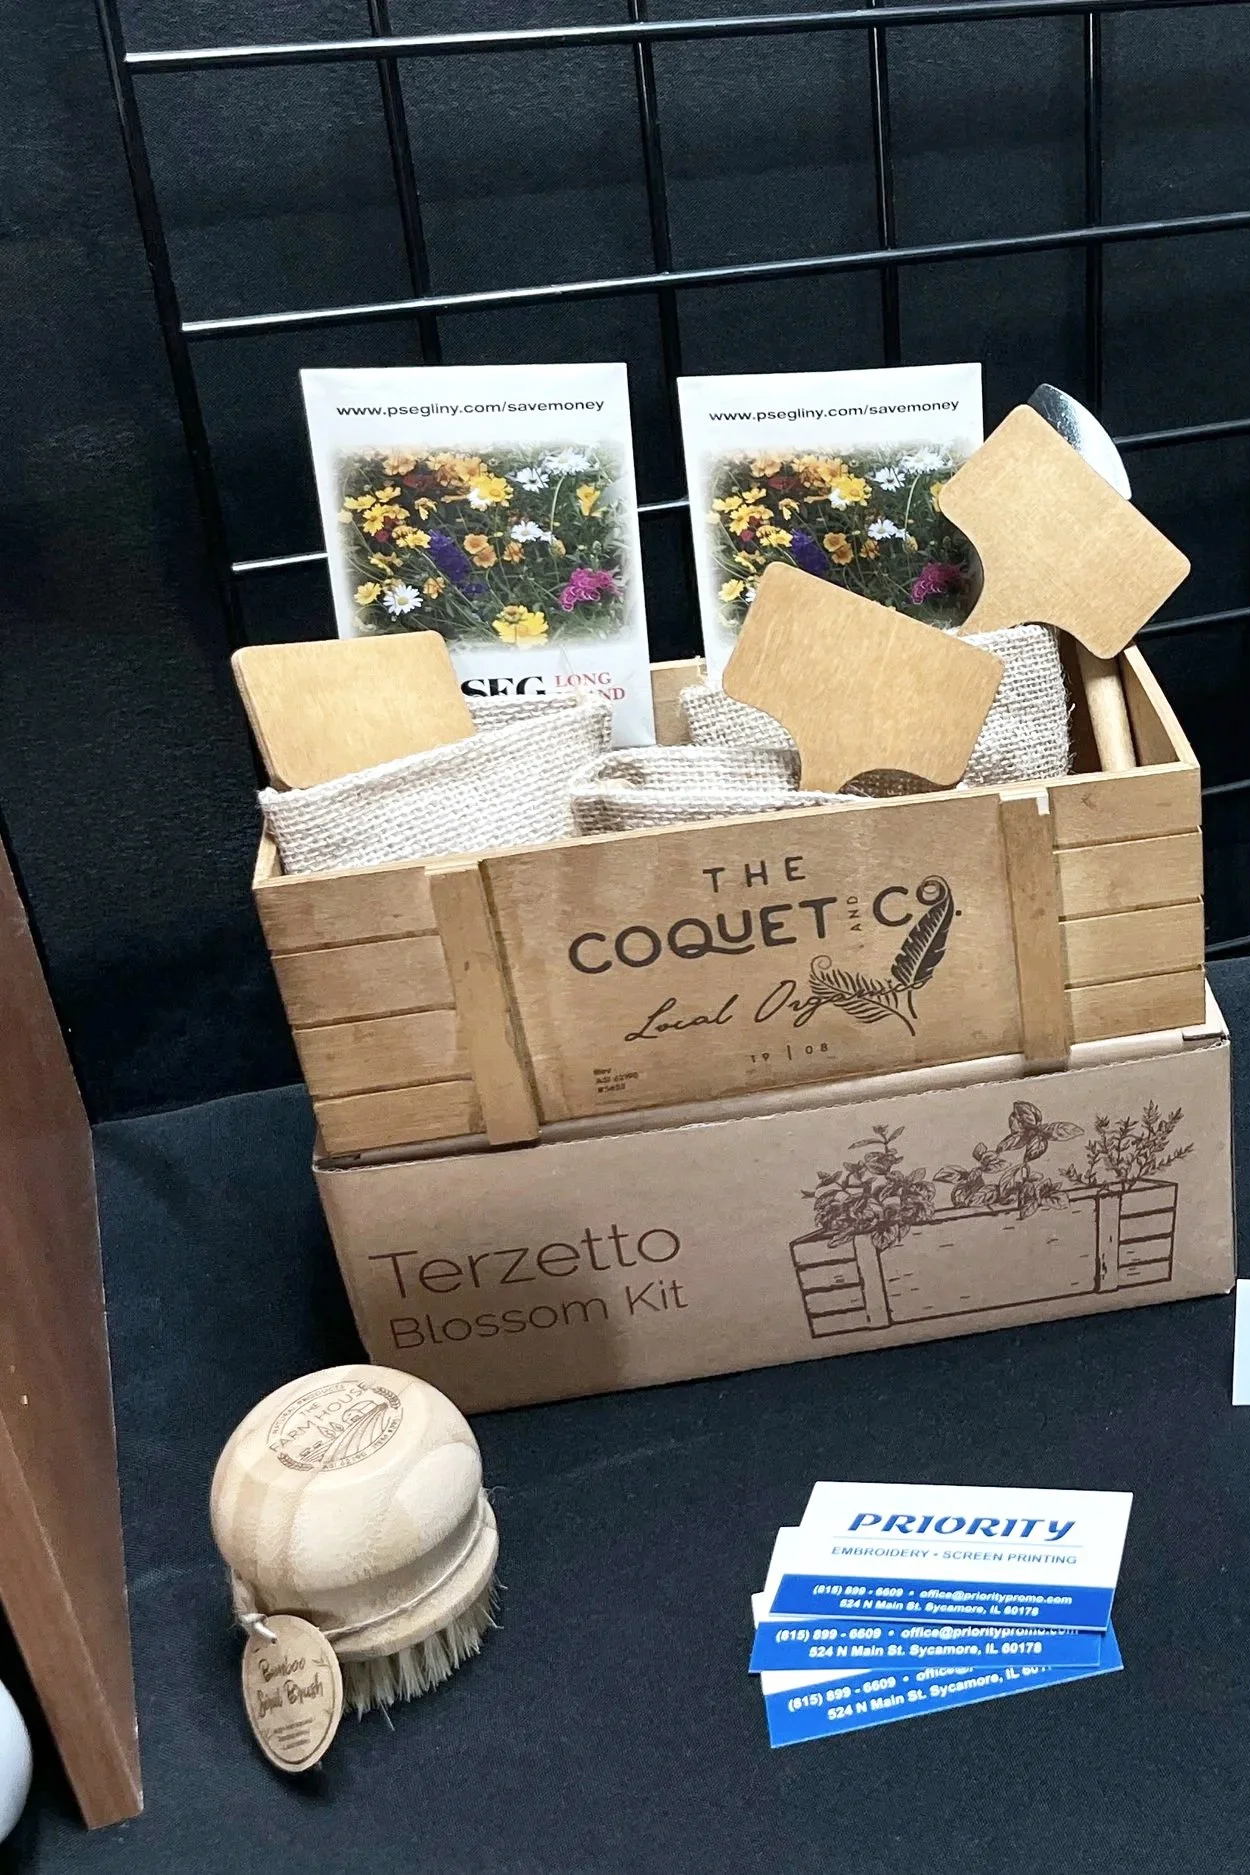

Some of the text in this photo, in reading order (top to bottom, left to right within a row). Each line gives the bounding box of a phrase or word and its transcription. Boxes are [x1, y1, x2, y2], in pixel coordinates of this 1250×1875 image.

[336, 399, 605, 417] www.psegliny.com/savemoney
[708, 399, 960, 422] www.psegliny.com/savemoney
[460, 672, 612, 698] SEG LONG
[703, 856, 806, 893] THE
[569, 897, 838, 974] COQUET
[849, 895, 863, 932] AND
[624, 993, 739, 1041] Local
[368, 1224, 680, 1298] Terzetto
[389, 1279, 689, 1350] Blossom Kit
[300, 1402, 320, 1416] THE
[848, 1513, 1076, 1542] PRIORITY
[831, 1546, 1077, 1565] EMBROIDERY SCREEN PRINTING
[812, 1585, 842, 1596] (815)
[875, 1586, 904, 1598] 6609
[919, 1588, 1073, 1606] office@prioritypromo.com
[839, 1598, 860, 1609] 524
[862, 1599, 873, 1609] N
[875, 1599, 904, 1610] Main
[924, 1602, 987, 1615] Sycamore,
[989, 1604, 1001, 1614] IL
[1003, 1605, 1039, 1617] 60178
[775, 1629, 810, 1644] (815)
[812, 1628, 838, 1640] 899
[848, 1627, 882, 1640] 6609
[808, 1641, 1042, 1658] 524 N Main St. Sycamore, IL 60178
[788, 1693, 824, 1712] (815)
[826, 1686, 852, 1702] 899
[863, 1676, 896, 1693] 6609
[827, 1704, 853, 1720] 524
[856, 1701, 867, 1714] N
[870, 1694, 905, 1711] Main
[907, 1688, 927, 1702] St.
[929, 1672, 1004, 1698] Sycamore,
[1005, 1666, 1020, 1680] IL
